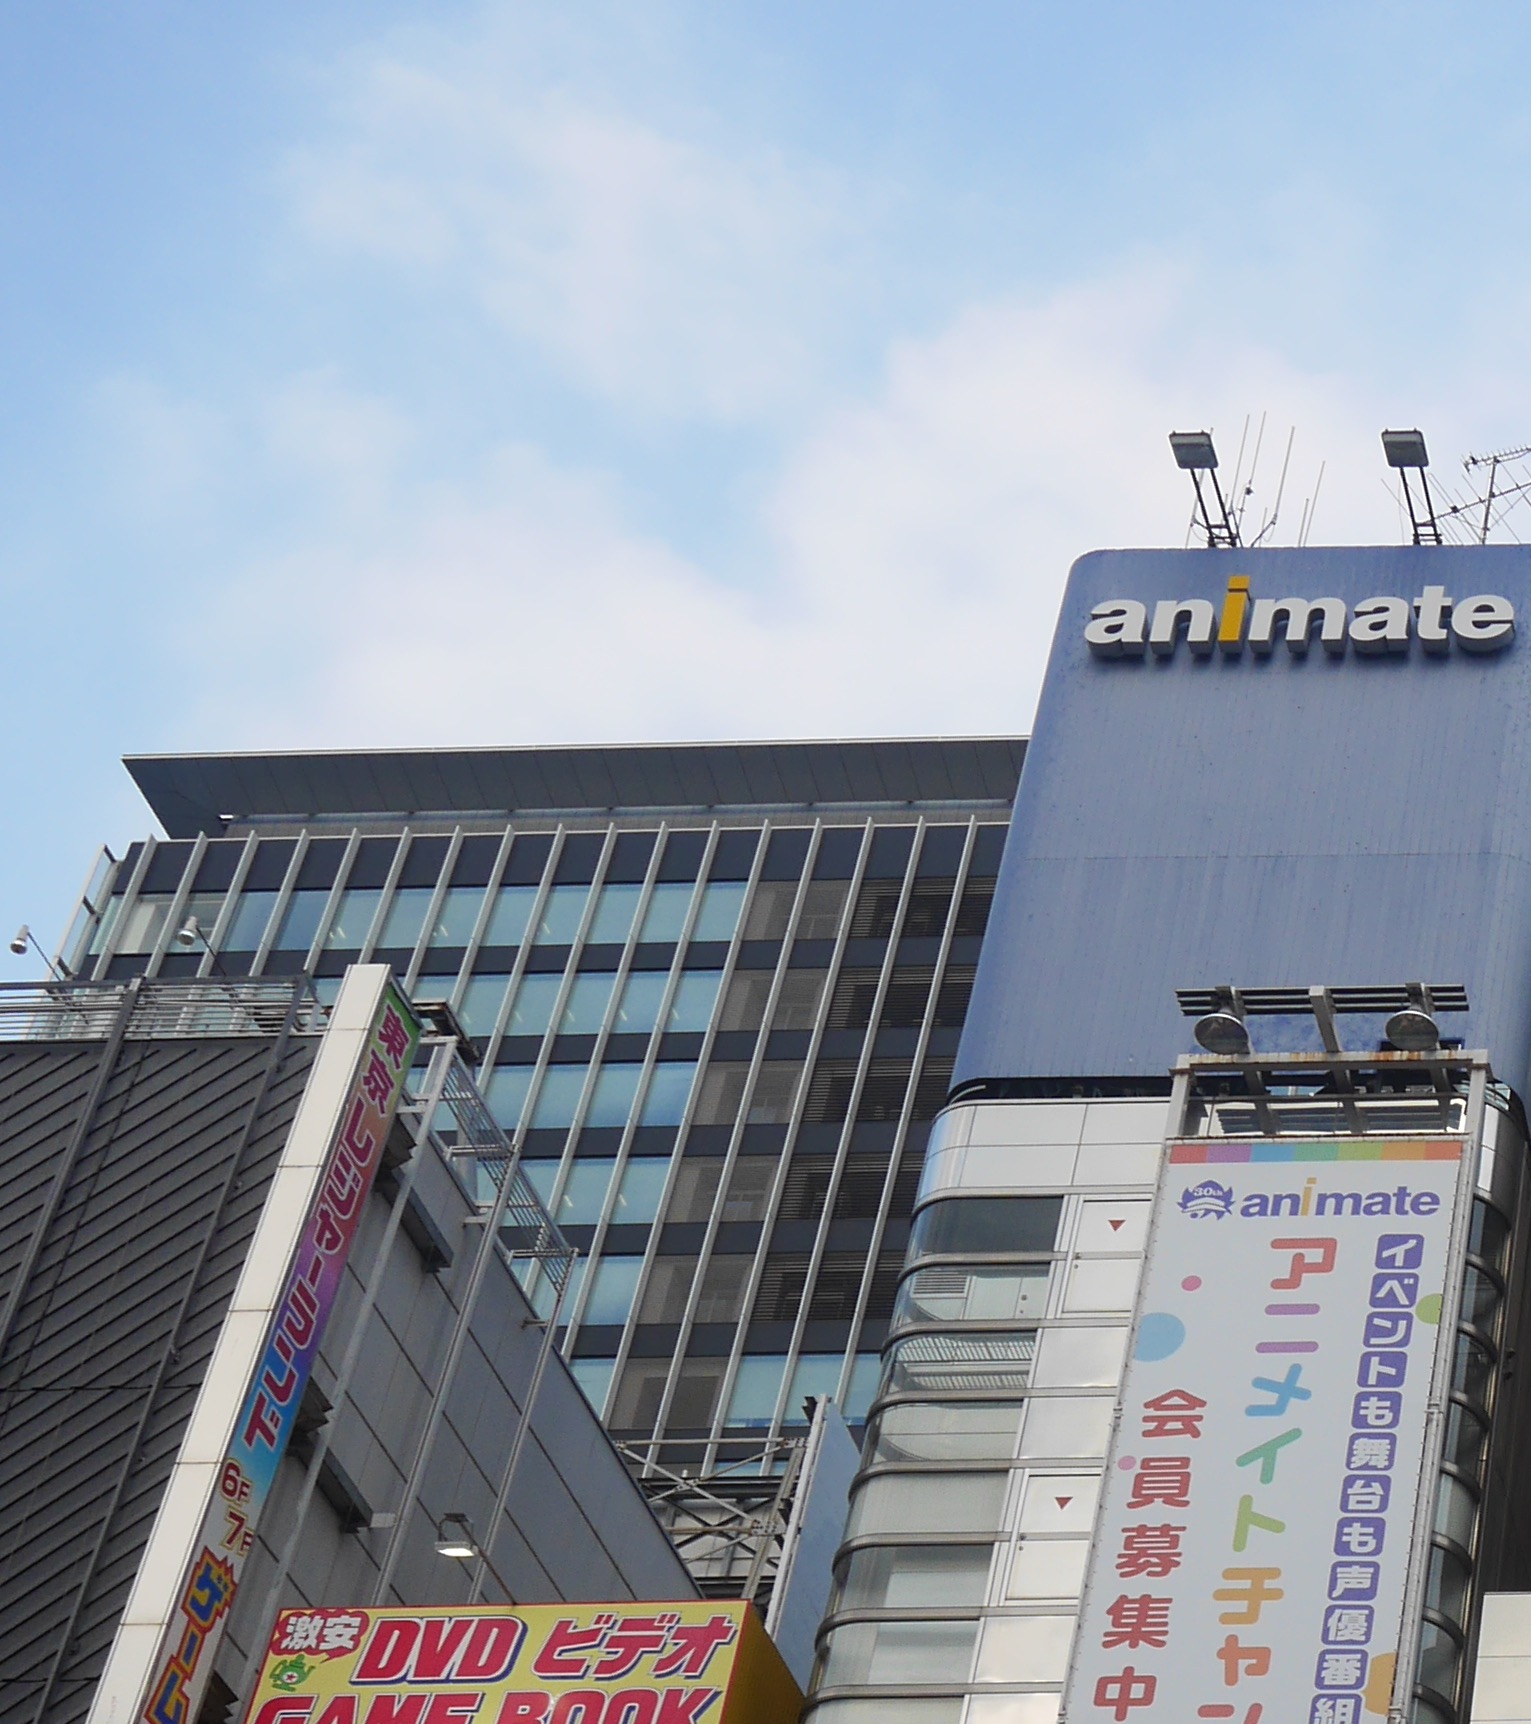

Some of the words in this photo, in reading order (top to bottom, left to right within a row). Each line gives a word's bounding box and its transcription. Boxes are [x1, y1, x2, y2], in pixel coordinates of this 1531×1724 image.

[1084, 575, 1515, 657] animate
[1240, 1177, 1441, 1217] animate
[243, 1003, 410, 1453] 東京レジャーランド
[220, 1459, 250, 1504] 6F
[223, 1507, 254, 1556] 7F
[1093, 1388, 1207, 1722] 会員募集中
[278, 1615, 363, 1651] 激安
[350, 1614, 525, 1685] DVD
[531, 1611, 738, 1682] ビデオ
